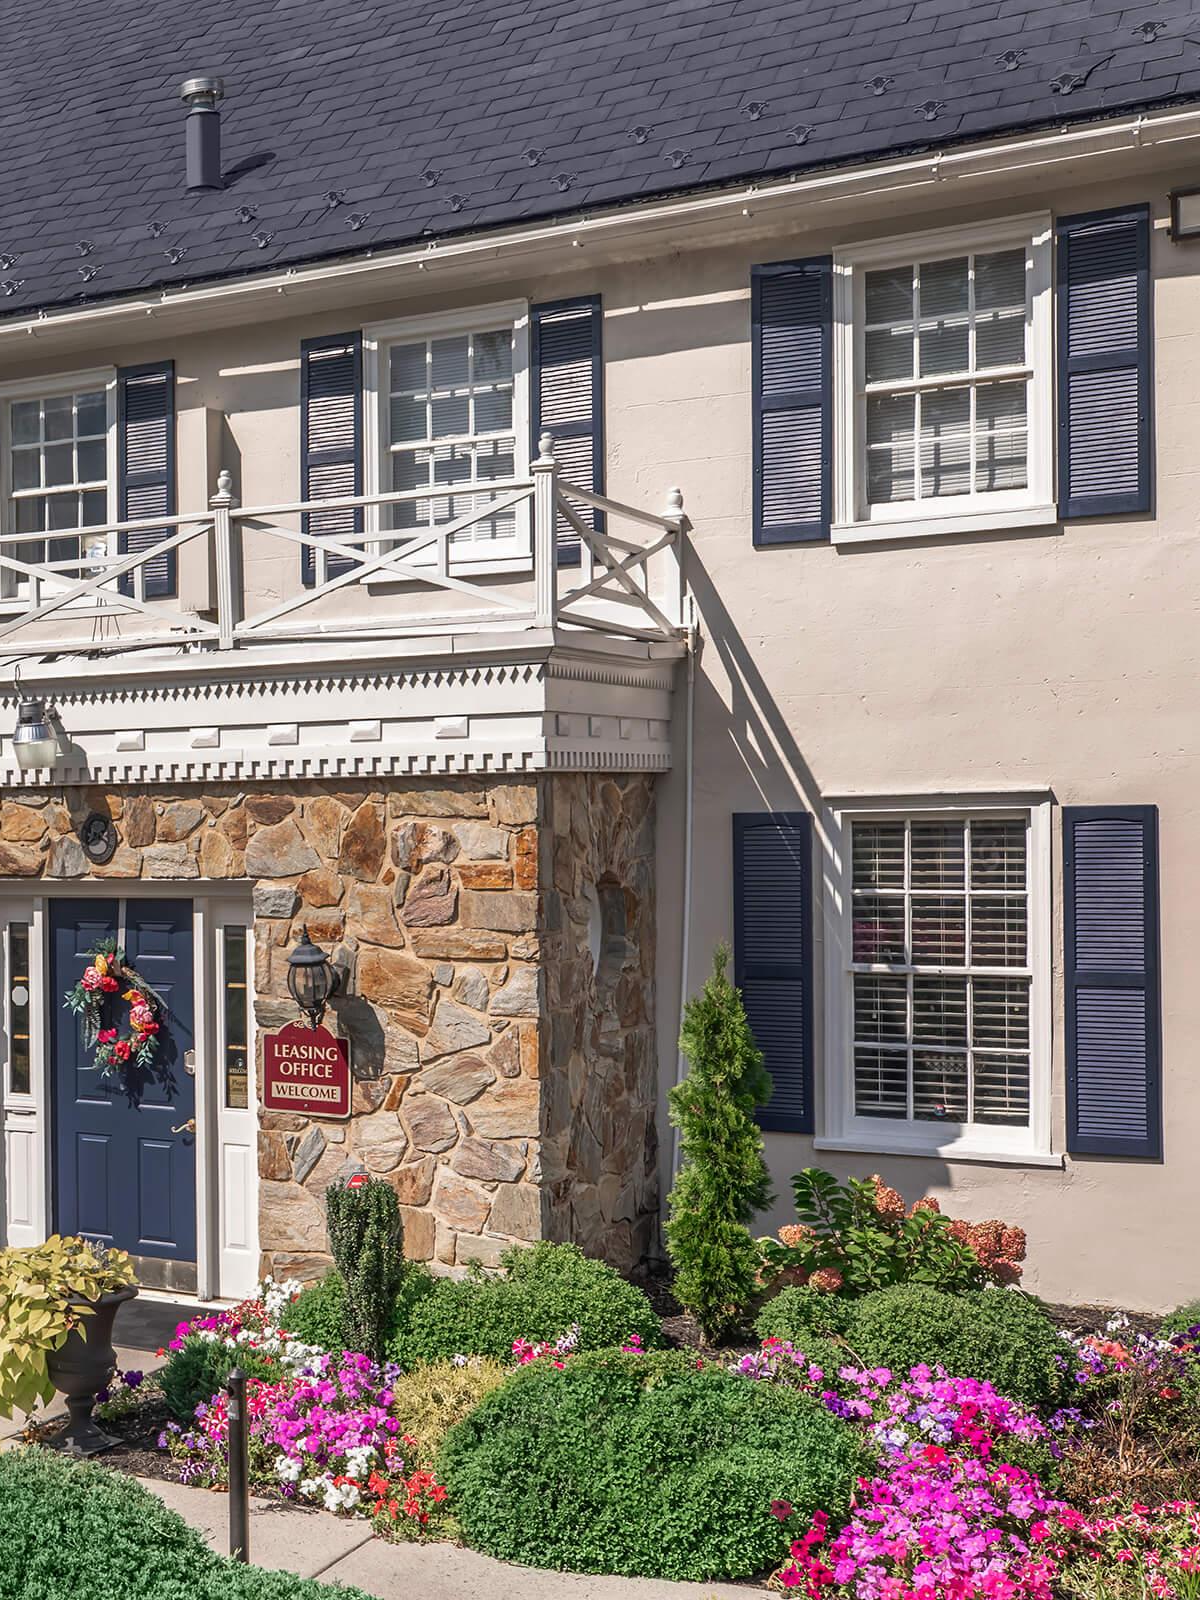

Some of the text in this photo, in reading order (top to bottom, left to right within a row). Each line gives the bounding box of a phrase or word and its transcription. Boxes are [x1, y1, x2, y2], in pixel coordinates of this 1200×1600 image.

[274, 1043, 338, 1062] LEASING
[279, 1061, 333, 1078] OFFICE
[275, 1084, 337, 1100] WELCOME
